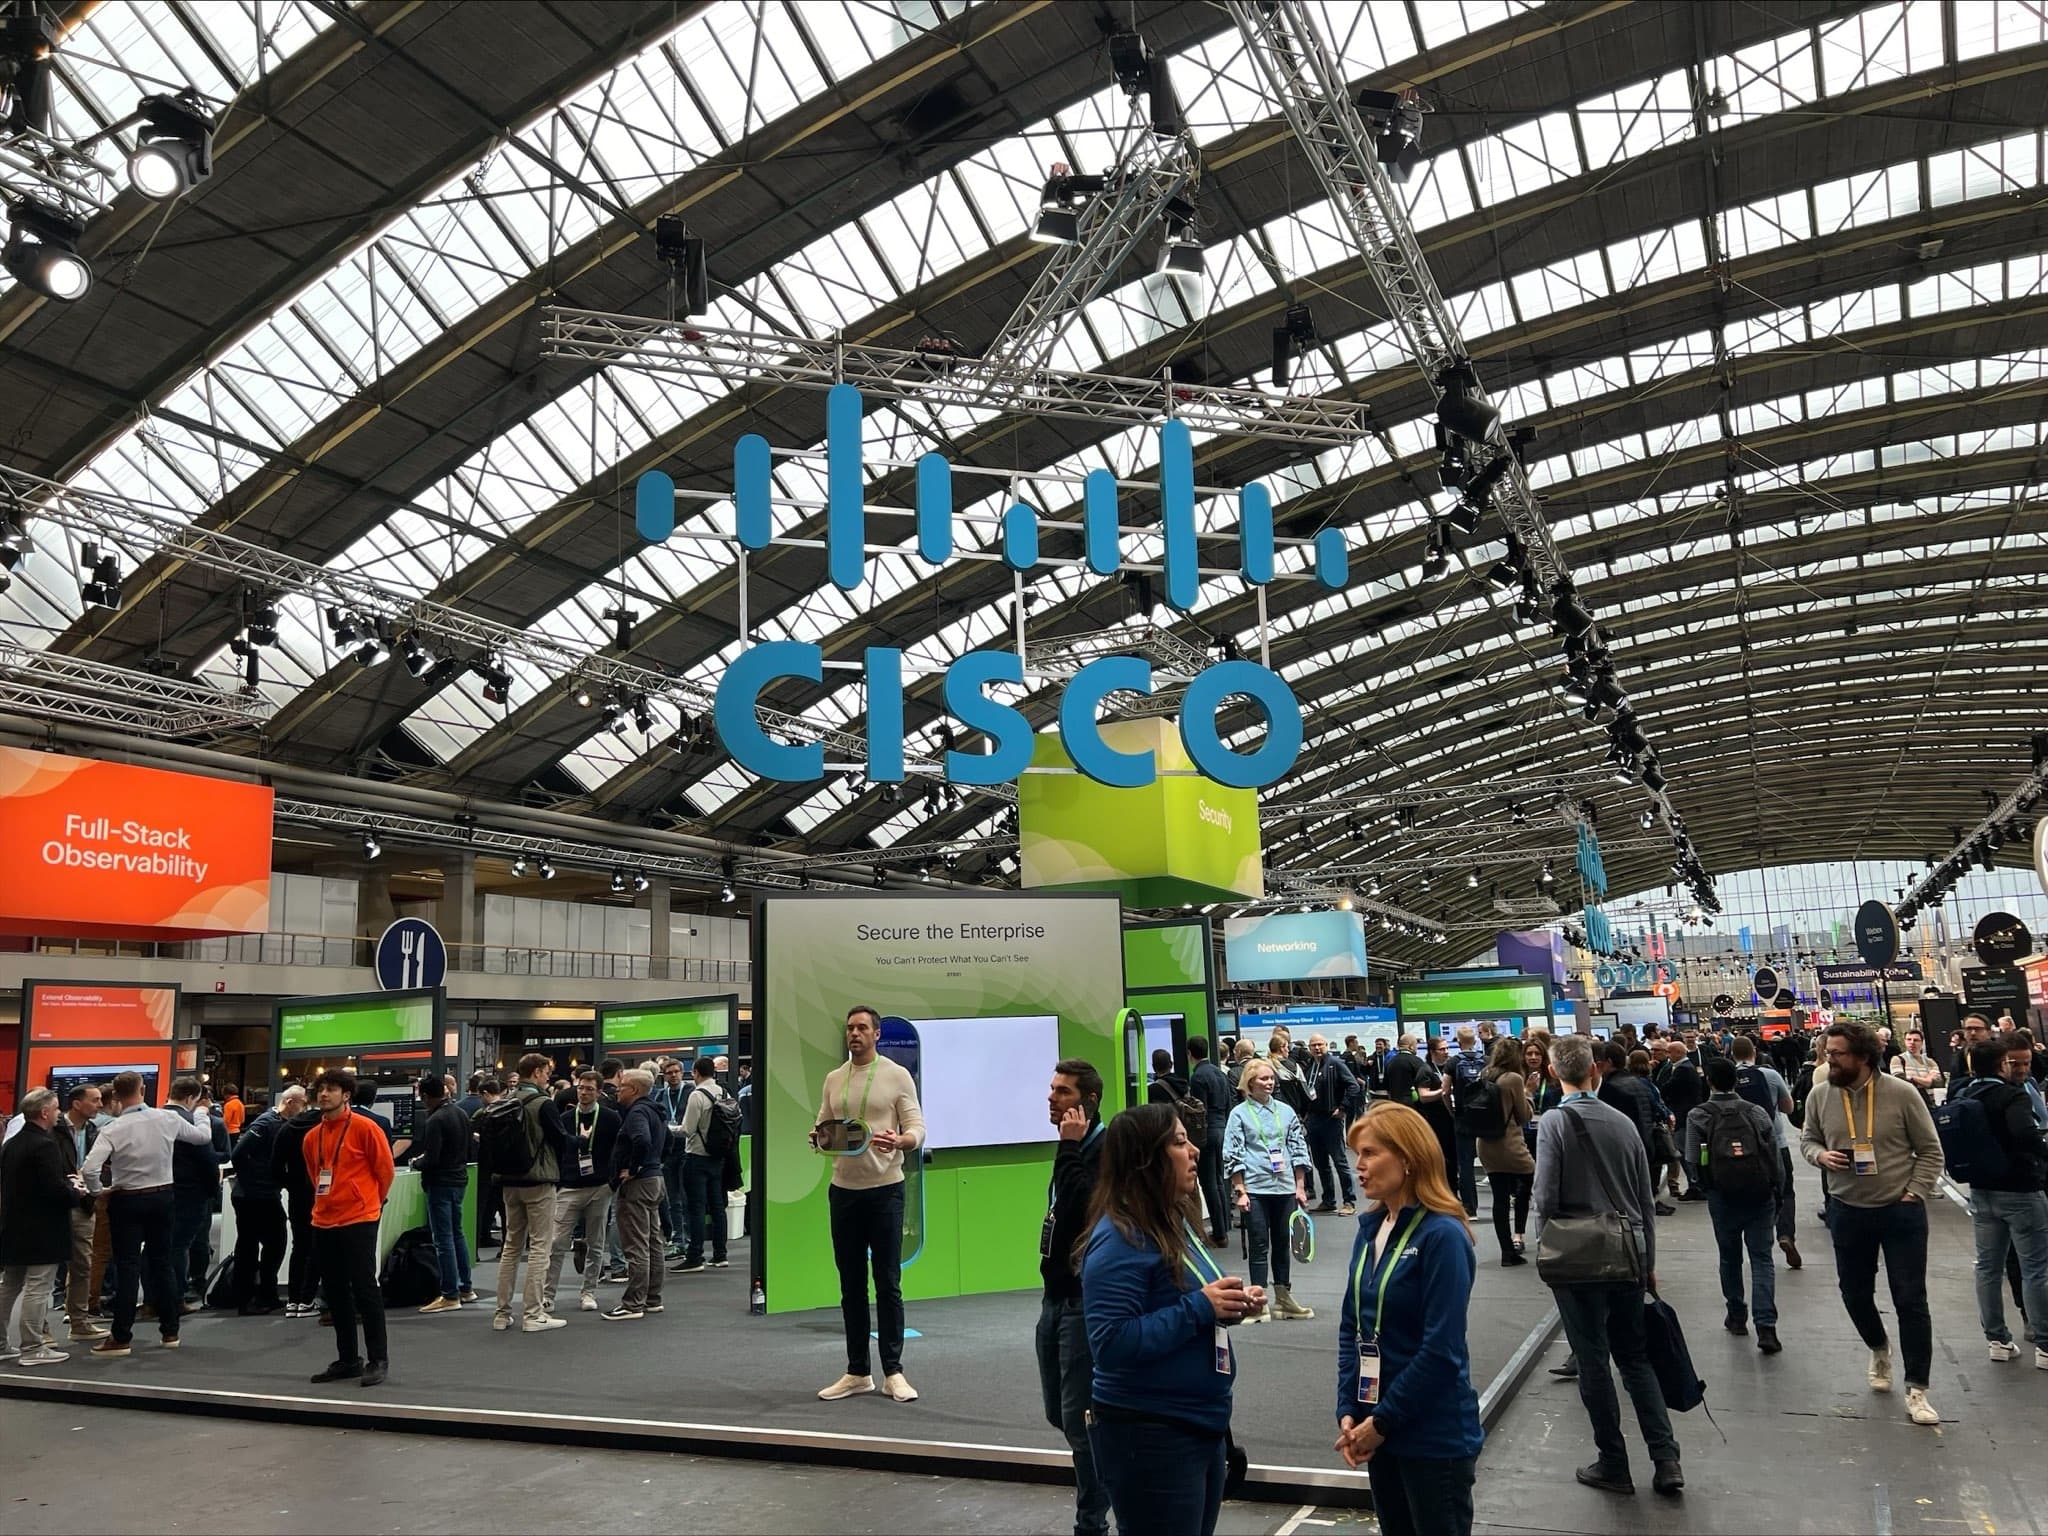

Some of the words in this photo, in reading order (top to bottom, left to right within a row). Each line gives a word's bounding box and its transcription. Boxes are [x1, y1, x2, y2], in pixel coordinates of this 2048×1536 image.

[714, 641, 1304, 788] CISCO
[1198, 799, 1232, 835] Security
[66, 814, 191, 849] Full-Stack
[42, 841, 208, 883] Observability
[856, 924, 921, 941] Secure
[926, 923, 954, 940] the
[960, 922, 1045, 942] Enterprise
[875, 956, 892, 966] You
[894, 956, 916, 965] Can't
[918, 955, 948, 965] Protect
[949, 955, 972, 964] What
[973, 955, 989, 964] You
[990, 954, 1012, 963] Can't
[1013, 953, 1030, 963] See
[1257, 940, 1317, 953] Networking
[1823, 968, 1881, 979] Sustainability
